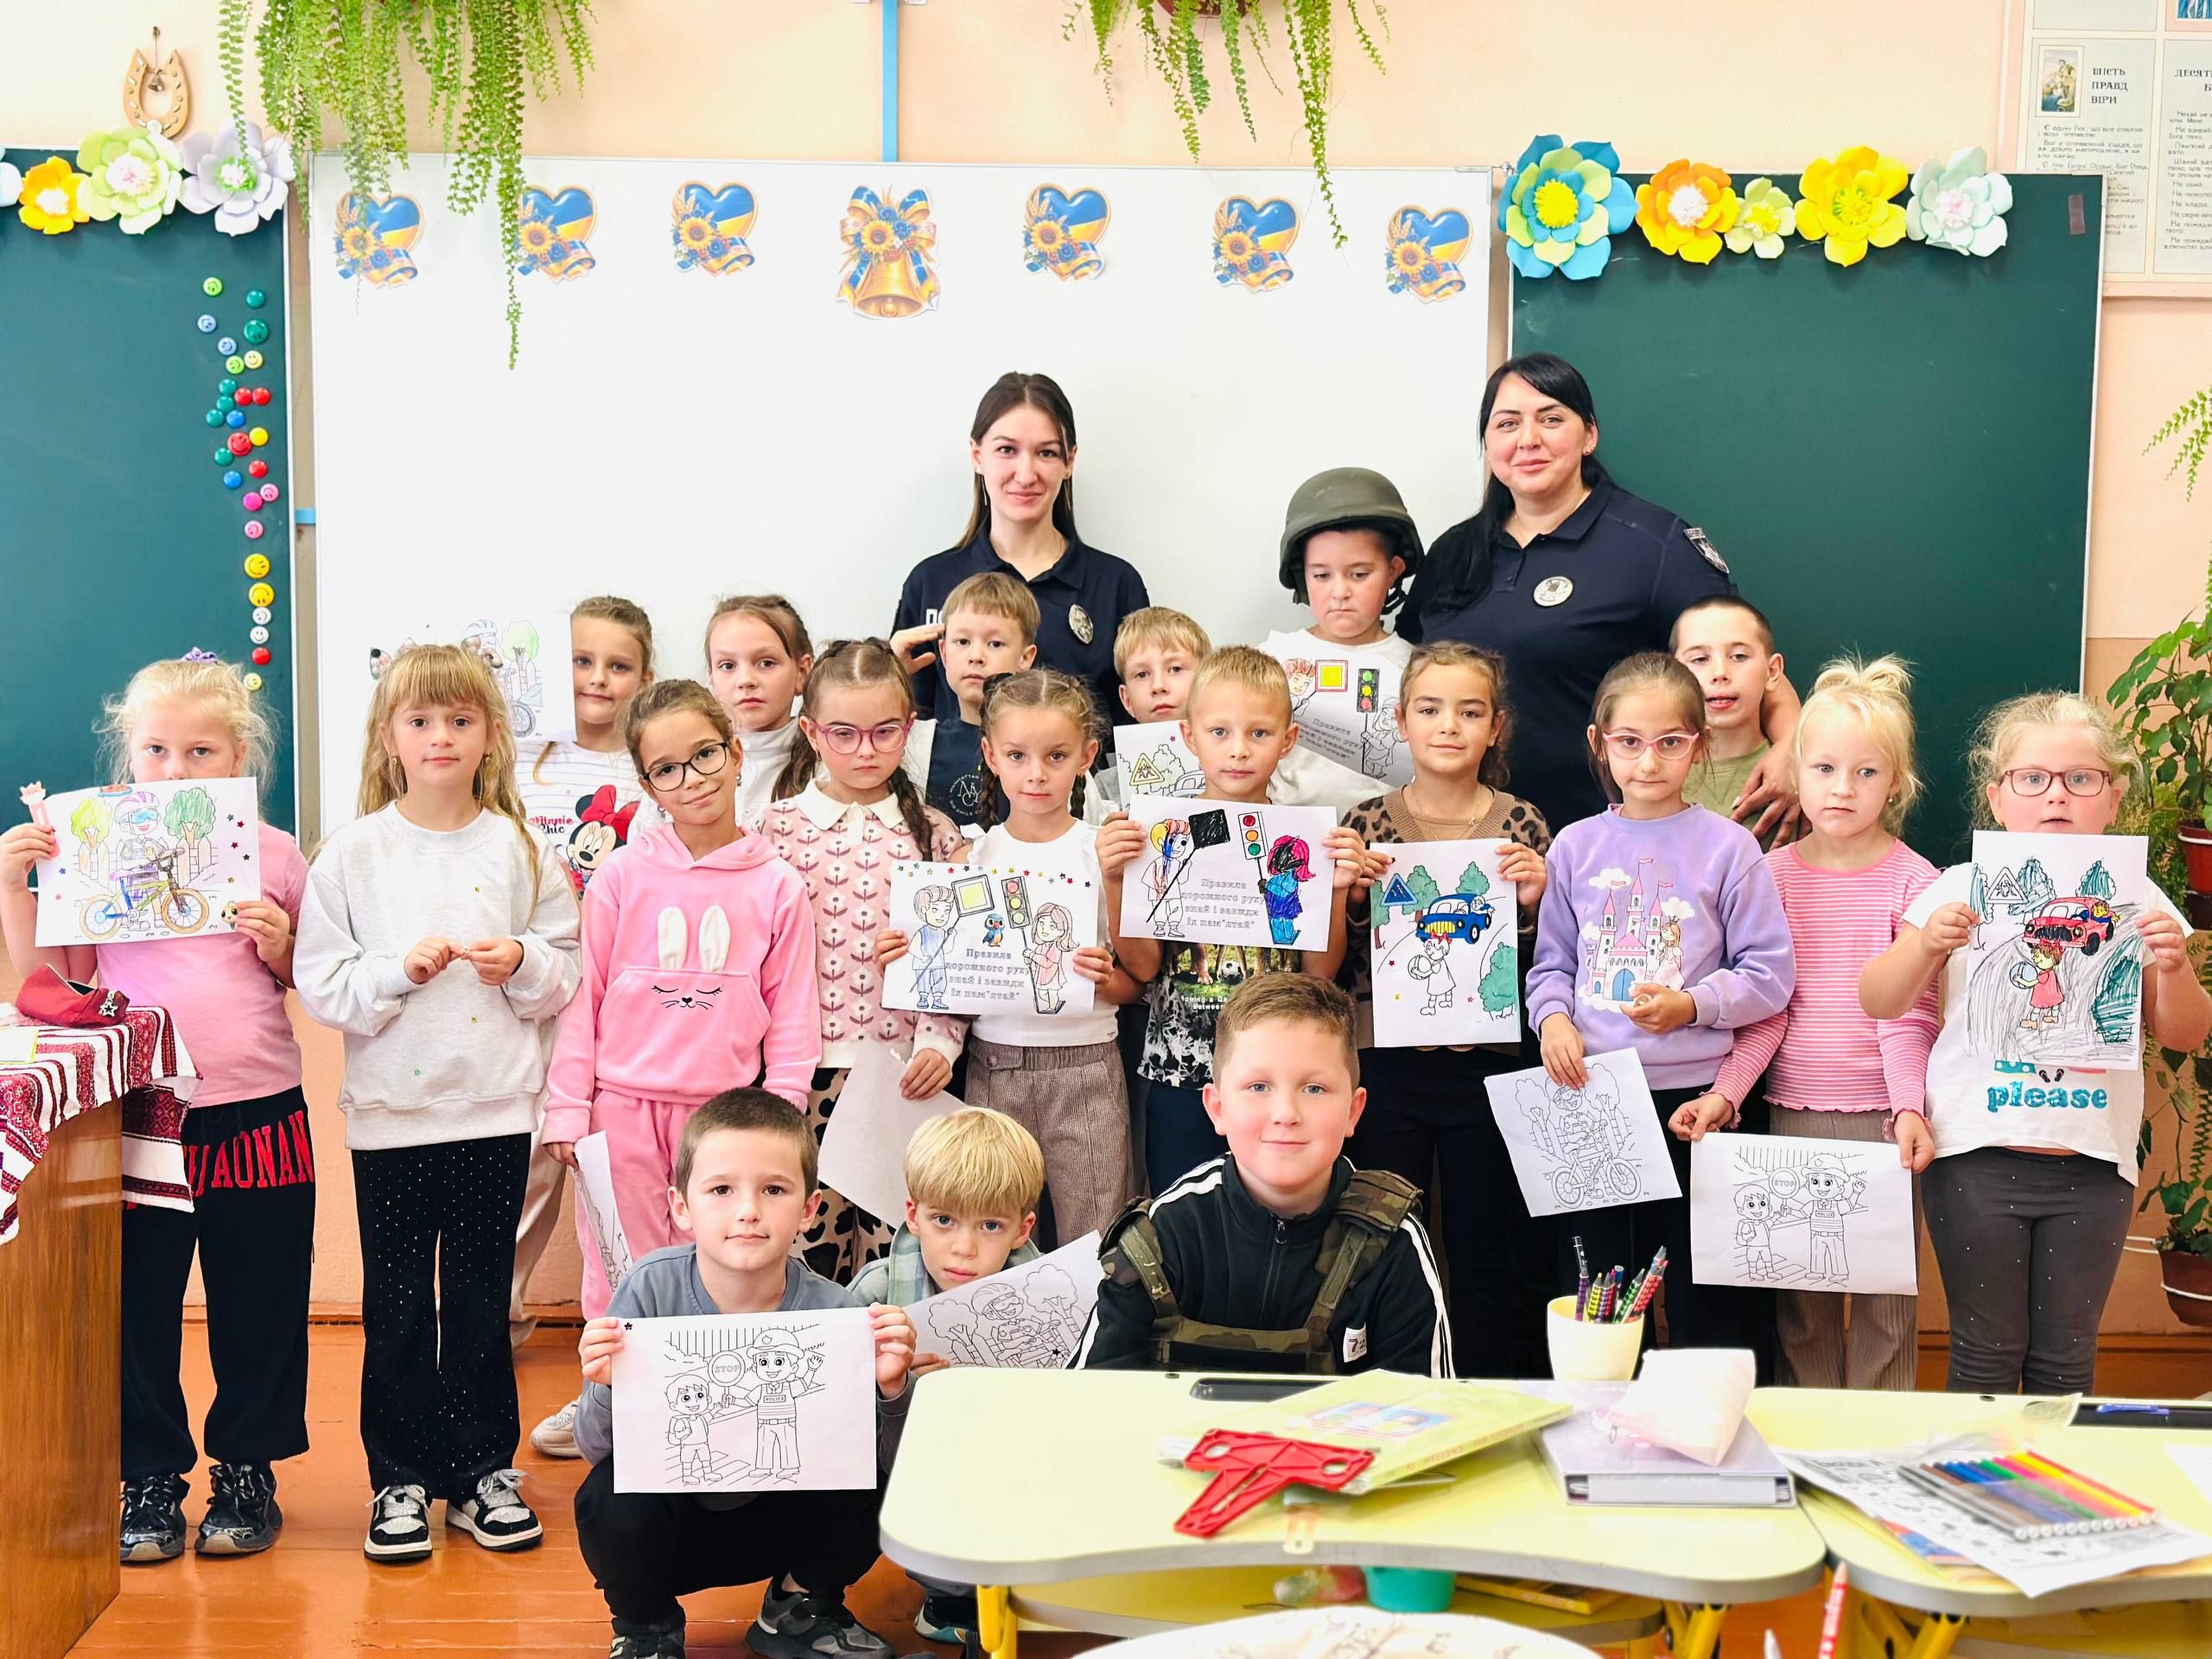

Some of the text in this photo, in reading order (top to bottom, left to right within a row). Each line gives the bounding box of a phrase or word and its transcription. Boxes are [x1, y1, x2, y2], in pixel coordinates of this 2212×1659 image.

[2092, 82, 2128, 92] ПРАВД
[2091, 96, 2117, 104] ВІРИ
[1201, 878, 1246, 889] Правила
[1181, 892, 1264, 904] дорожного руху
[1213, 906, 1217, 914] і
[1220, 908, 1259, 917] завжди
[966, 948, 1011, 959] Правила
[945, 962, 1030, 975] дорожного руху
[949, 976, 1024, 988] знай і завжди
[1987, 1081, 2107, 1113] please
